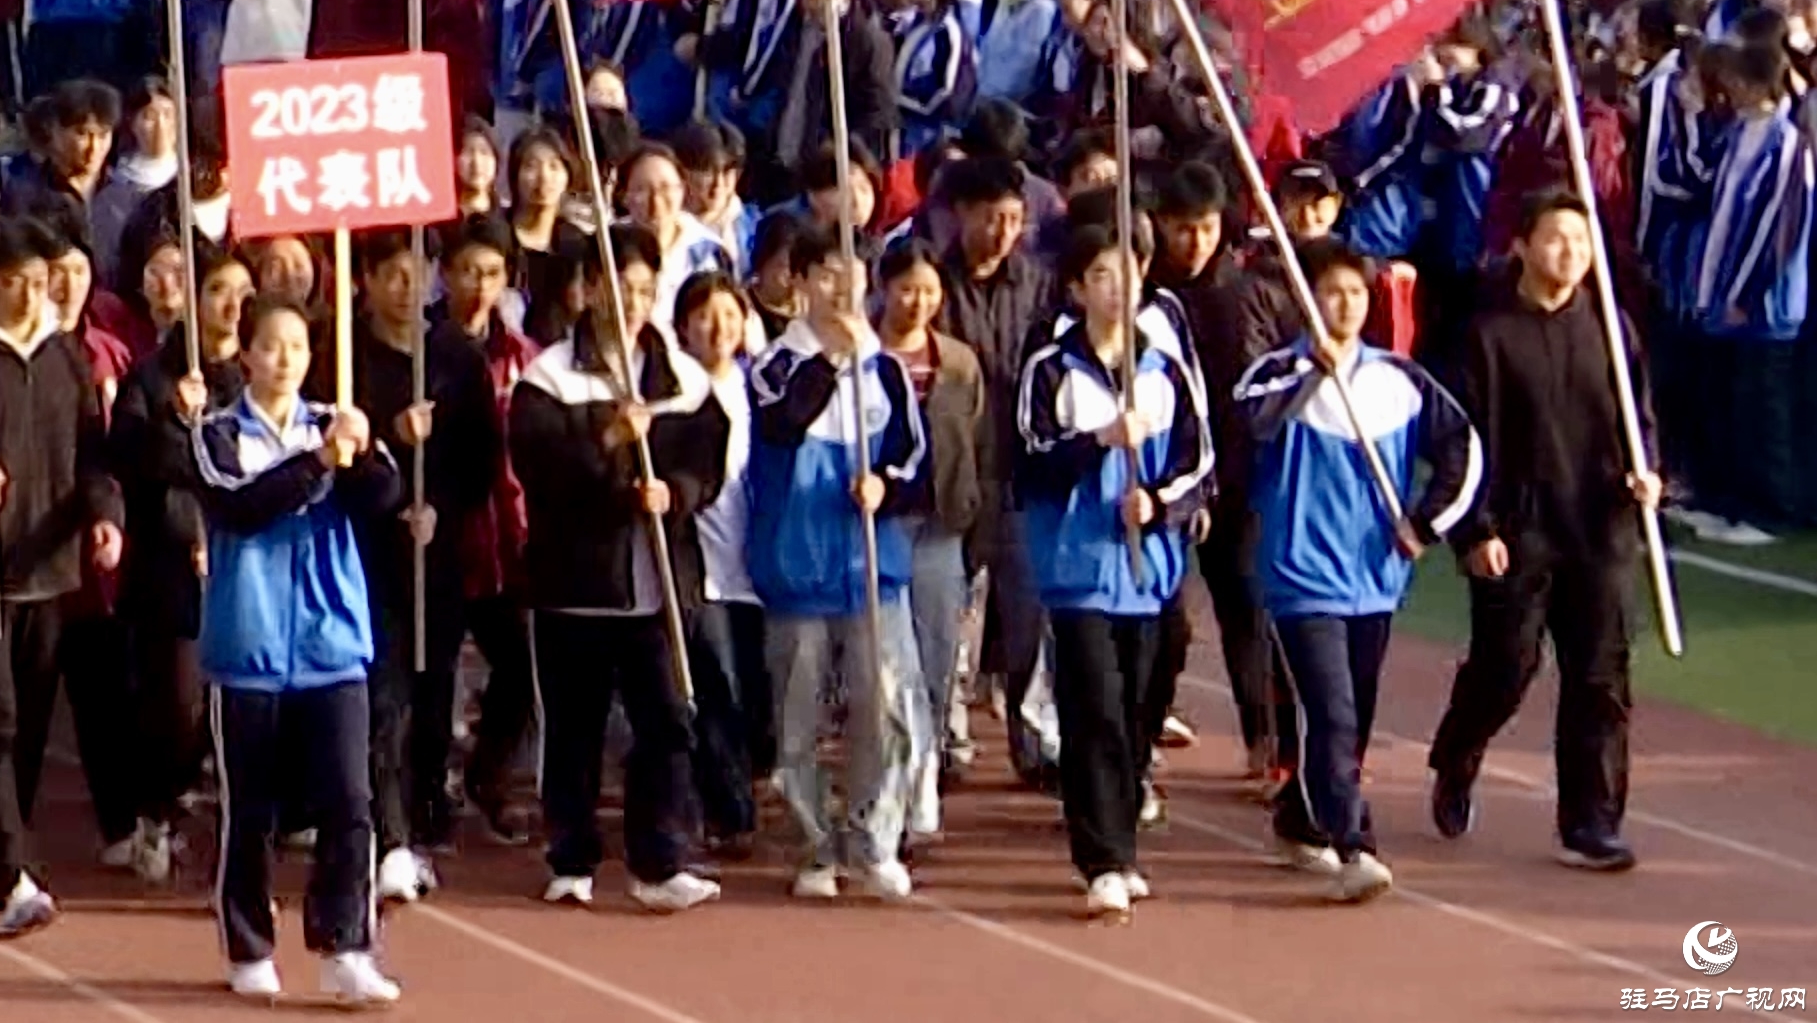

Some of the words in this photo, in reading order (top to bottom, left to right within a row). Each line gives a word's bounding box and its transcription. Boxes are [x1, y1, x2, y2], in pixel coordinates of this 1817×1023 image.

[249, 73, 427, 139] 2023级
[257, 145, 432, 216] 代表队
